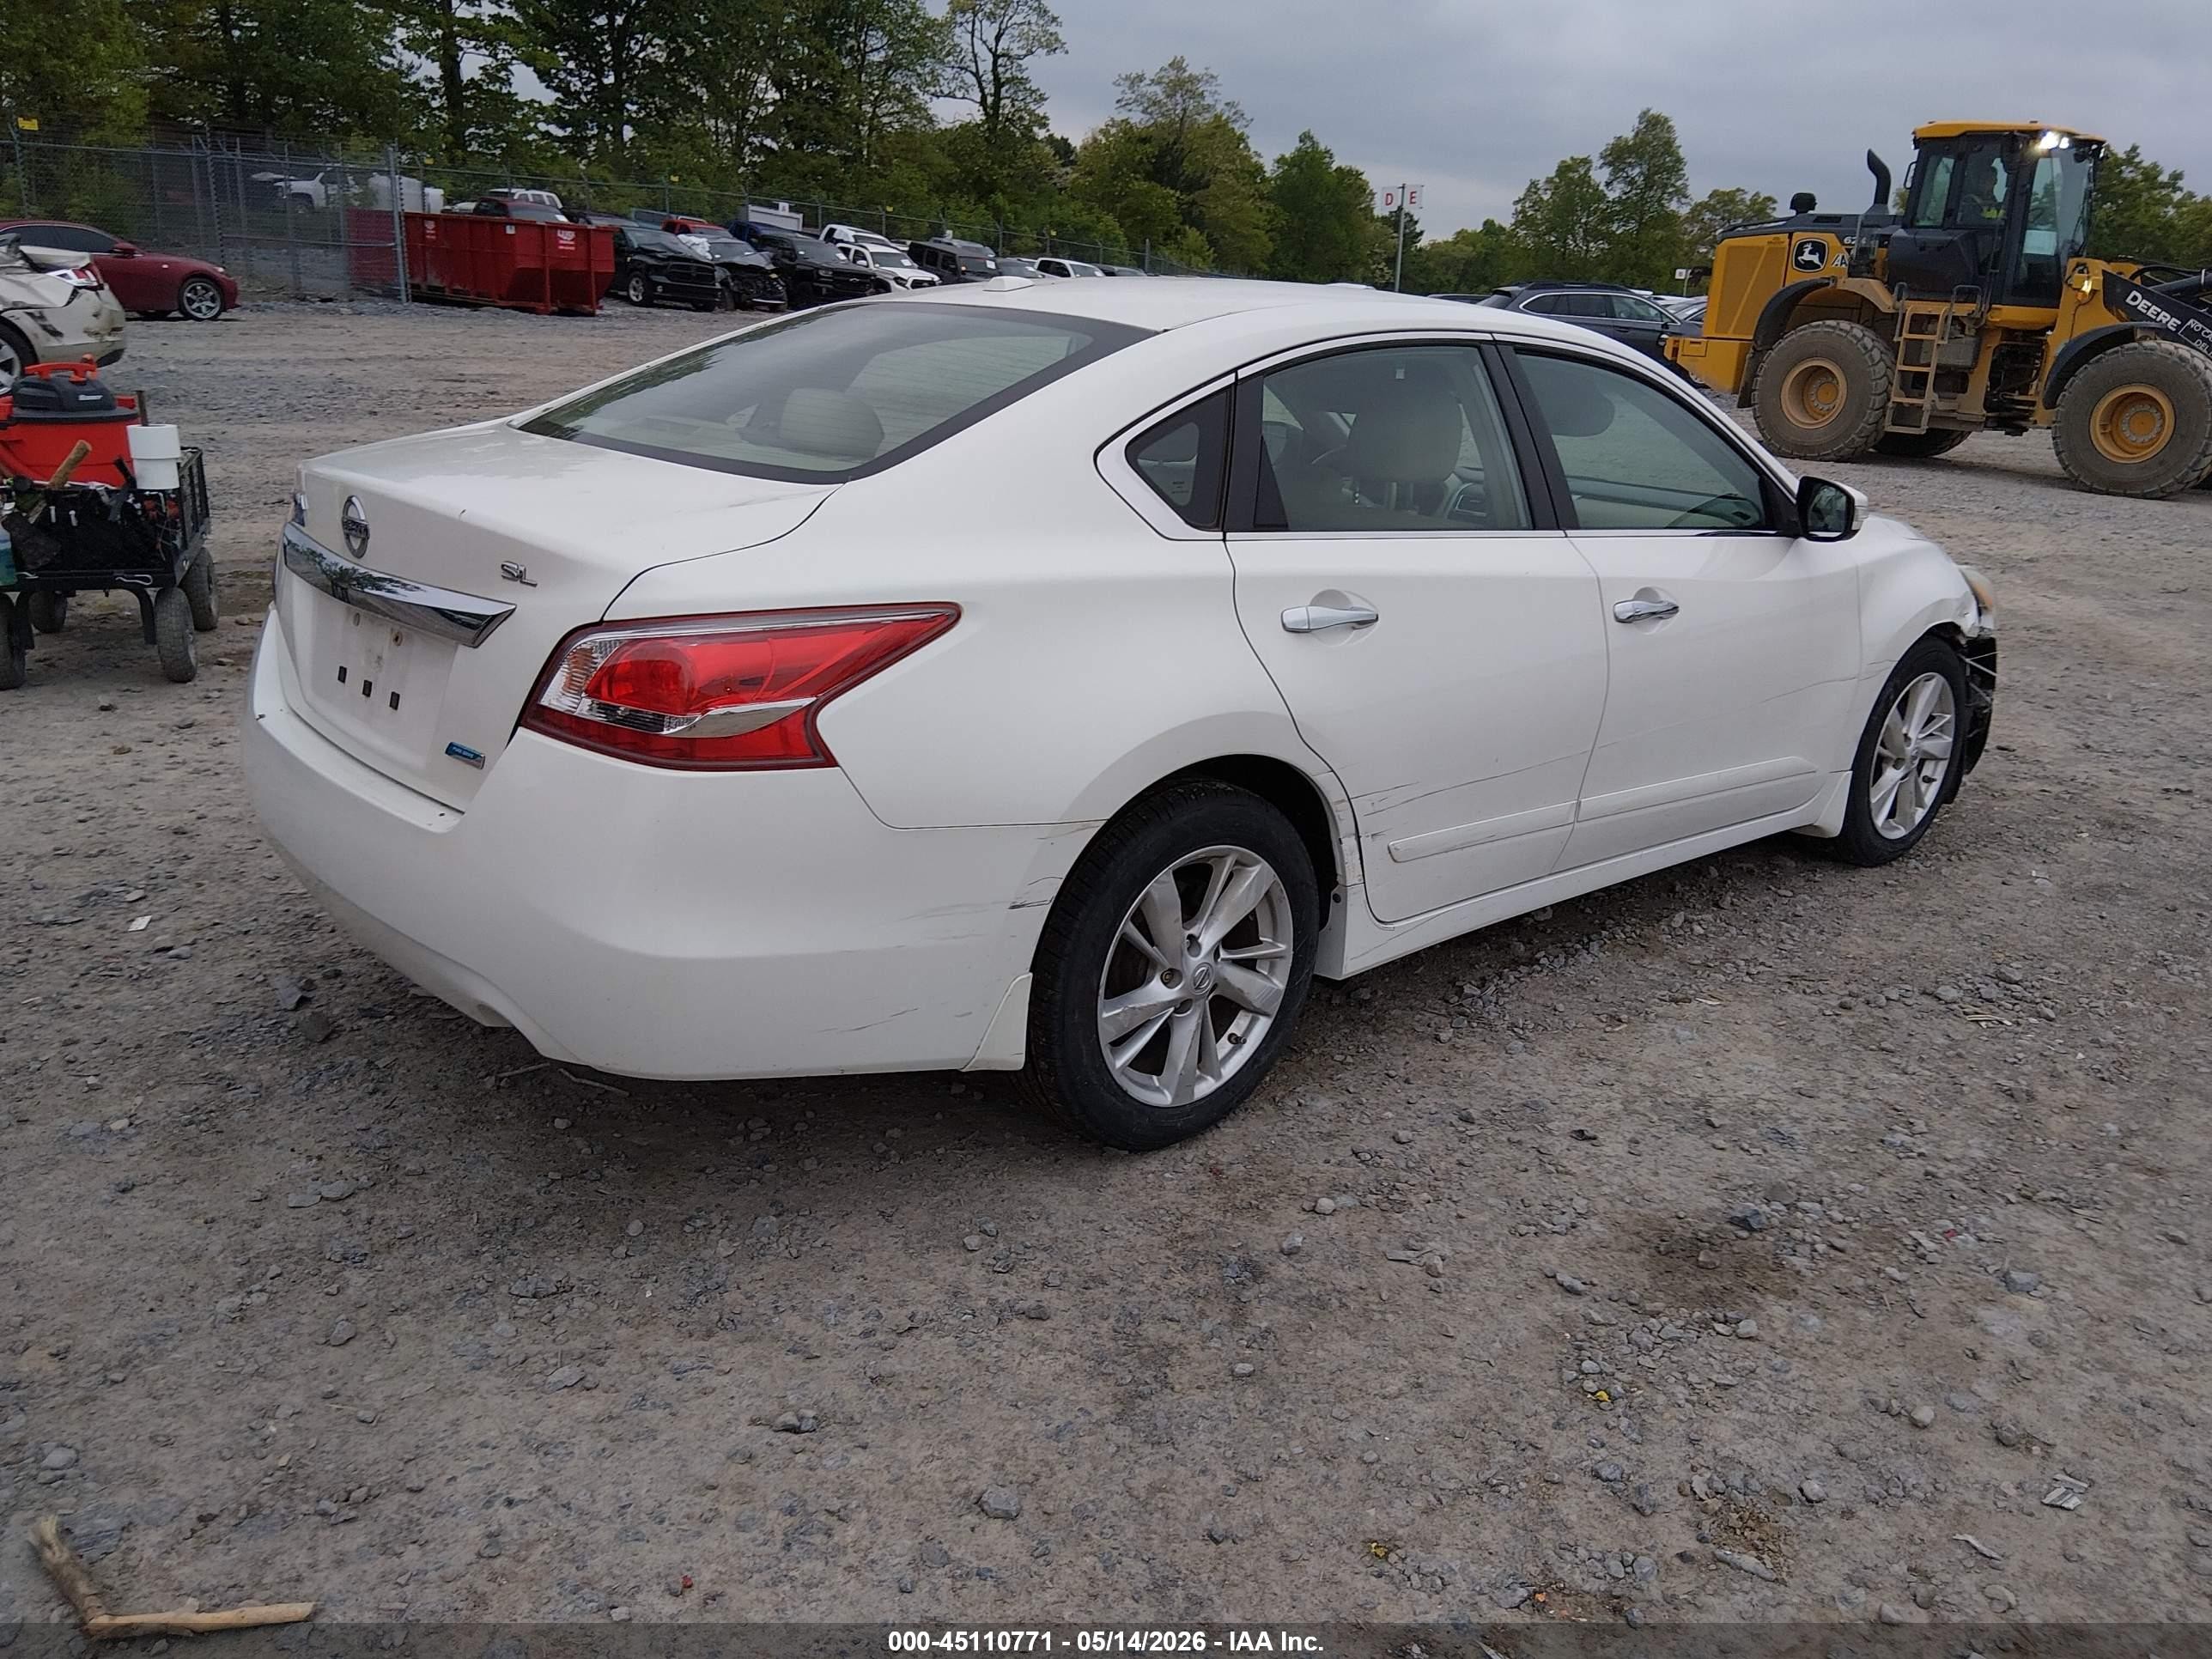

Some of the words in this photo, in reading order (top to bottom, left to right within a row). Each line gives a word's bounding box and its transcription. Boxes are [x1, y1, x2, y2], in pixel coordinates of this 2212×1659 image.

[1384, 192, 1394, 206] D
[1409, 191, 1417, 204] E
[2125, 290, 2182, 332] DEERE
[2187, 319, 2202, 332] NO
[501, 561, 538, 588] SL
